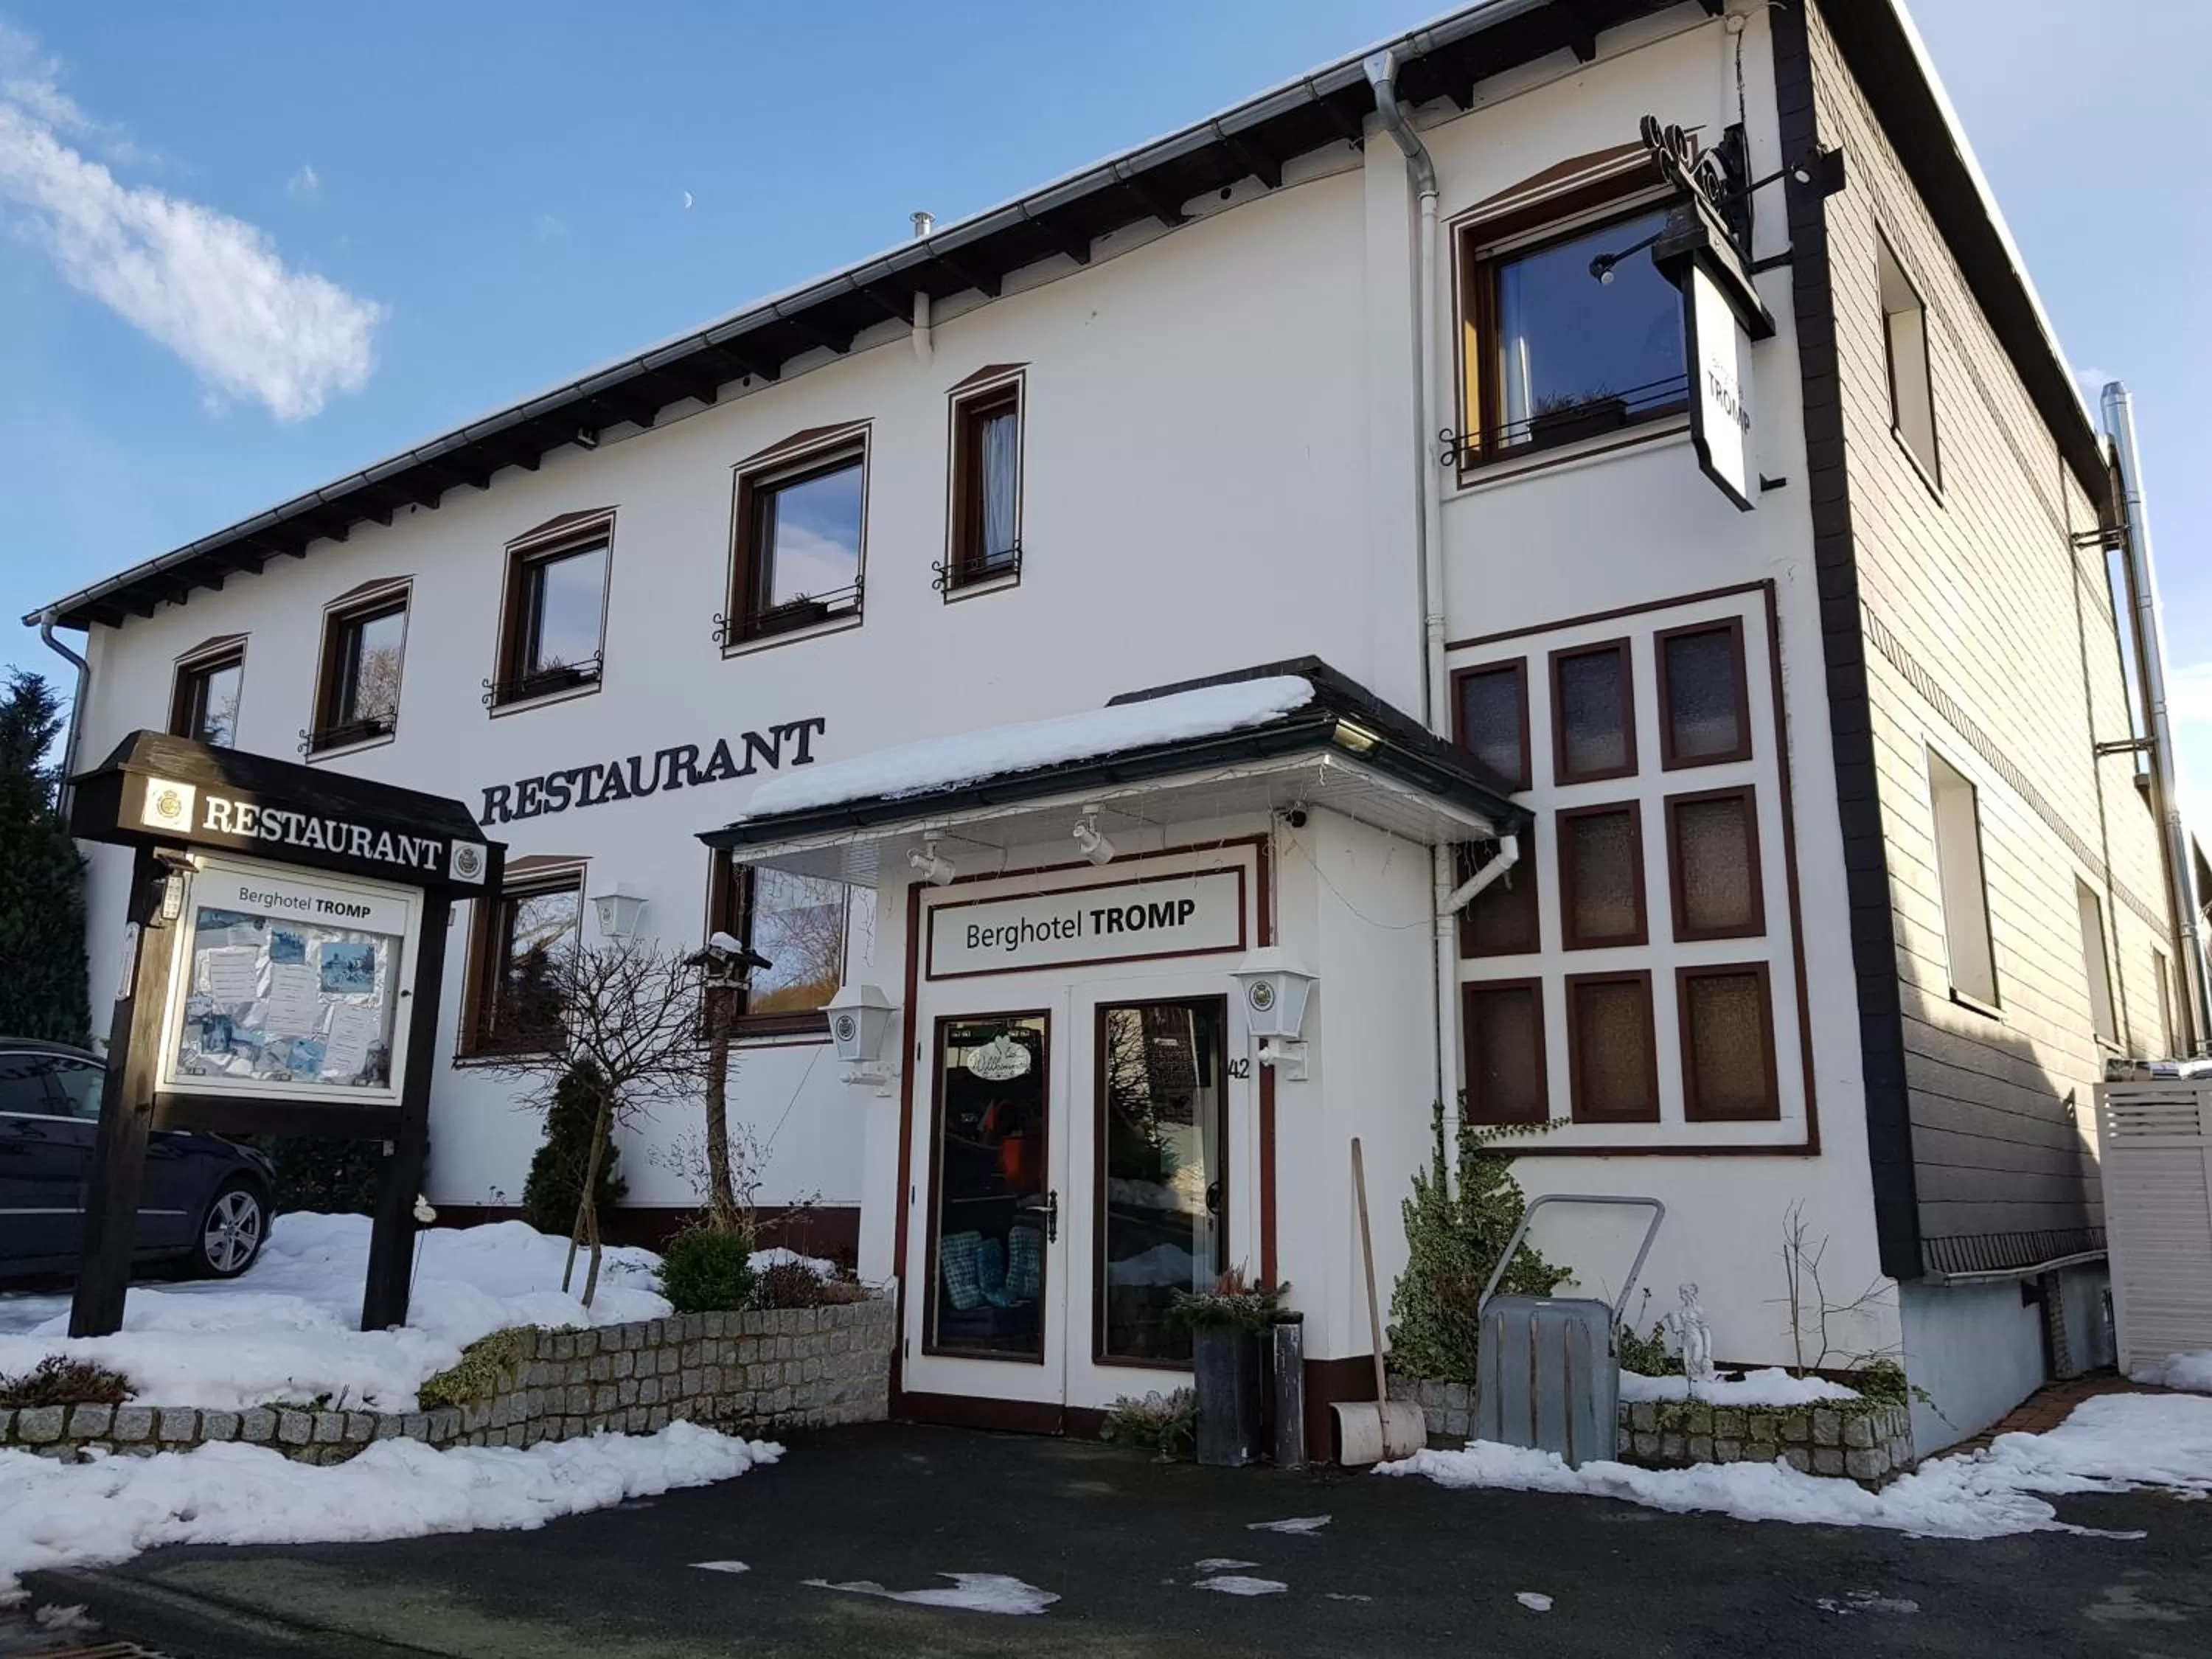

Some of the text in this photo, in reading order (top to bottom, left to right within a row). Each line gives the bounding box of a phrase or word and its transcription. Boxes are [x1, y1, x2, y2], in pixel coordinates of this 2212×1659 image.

[1708, 370, 1750, 436] TROMP
[479, 717, 825, 826] RESTAURANT
[202, 796, 442, 871] RESTAURANT
[238, 887, 372, 919] Berghotel TROMP
[966, 898, 1195, 951] Berghotel TROMP
[1228, 1058, 1250, 1079] 42
